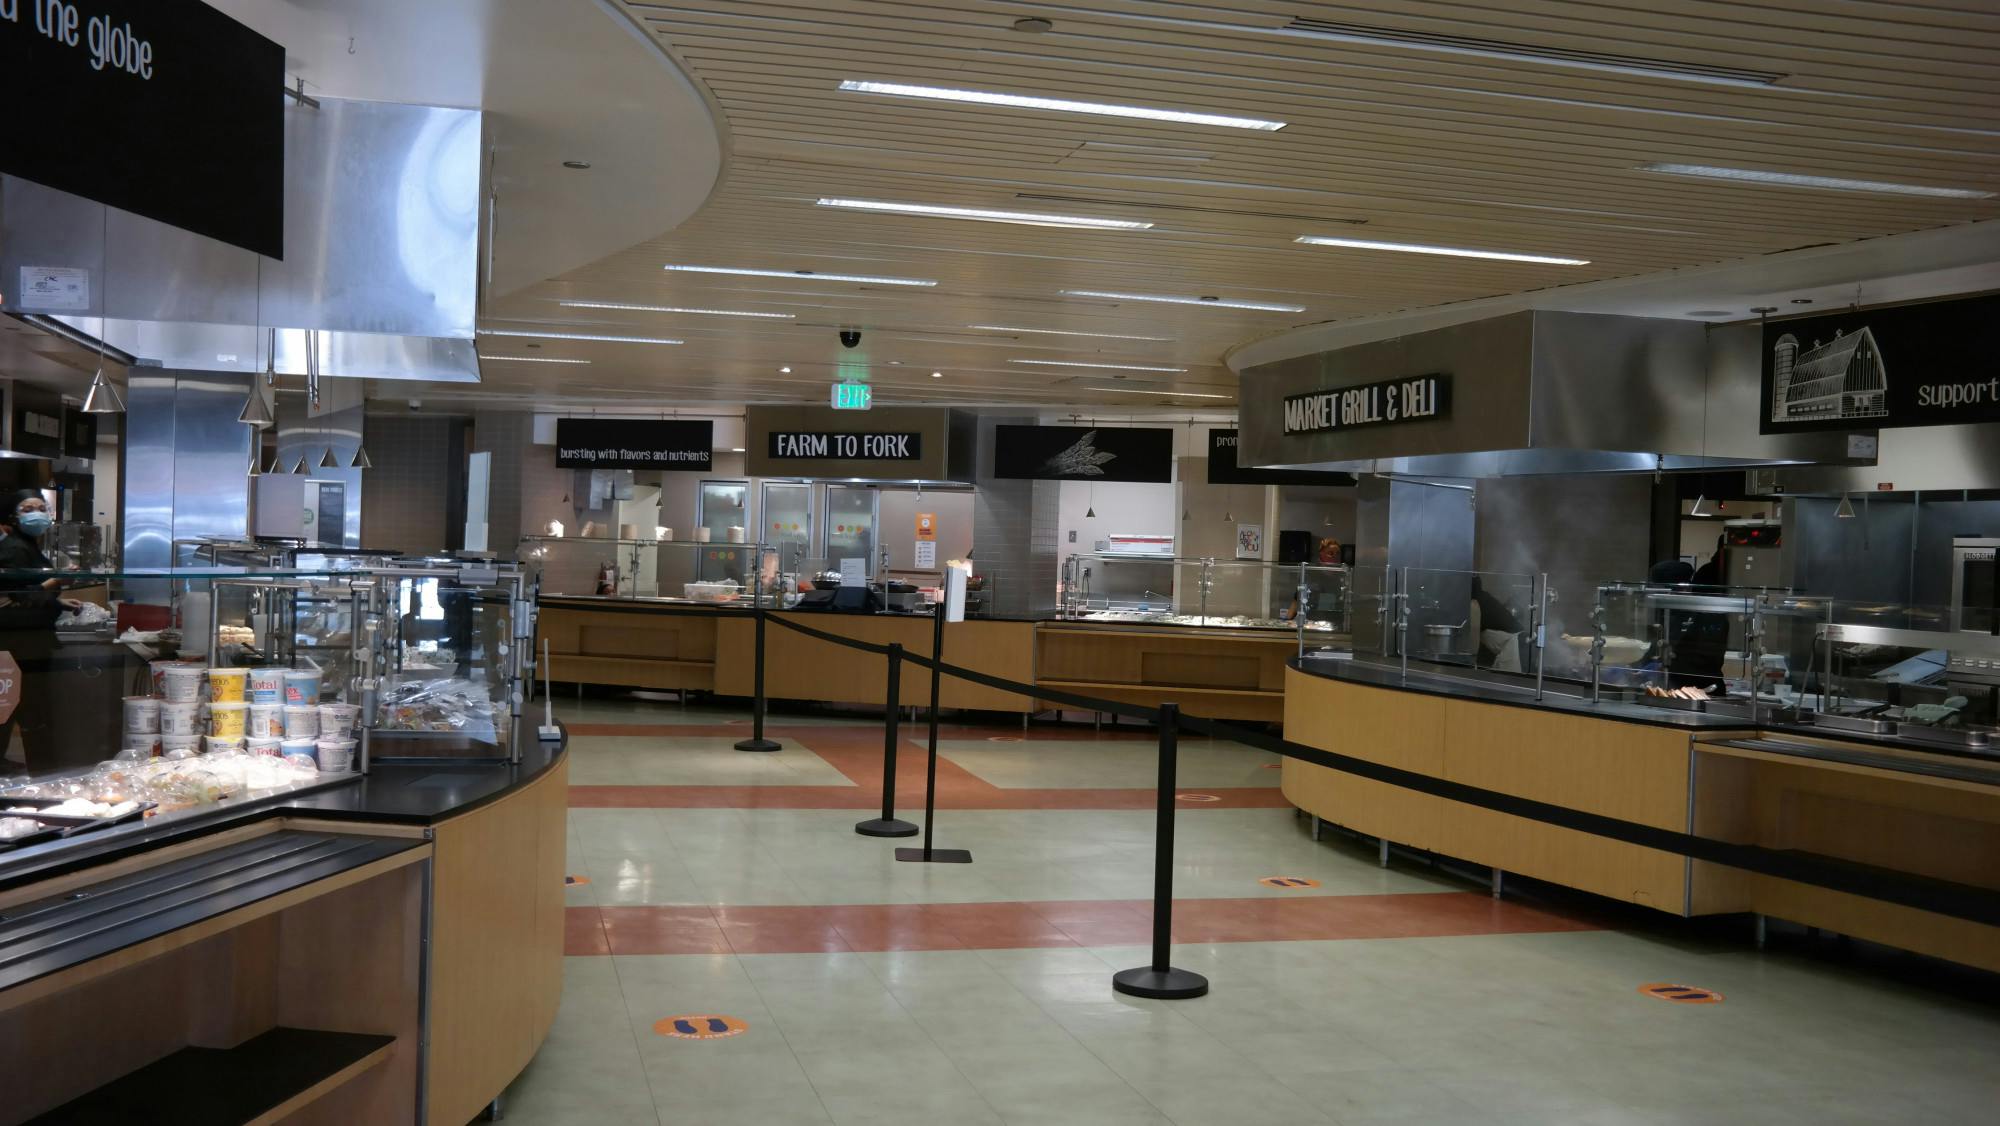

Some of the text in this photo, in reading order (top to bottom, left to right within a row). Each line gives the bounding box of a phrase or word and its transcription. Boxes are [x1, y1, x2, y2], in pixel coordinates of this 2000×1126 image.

[88, 14, 153, 80] globe
[838, 384, 868, 408] EXIT
[1918, 377, 2000, 408] support
[1284, 378, 1436, 433] MARKET GRILL & DELI
[560, 447, 709, 462] bursting with flavors and nutrients
[777, 434, 909, 458] FARM TO FORK
[251, 679, 278, 690] Total
